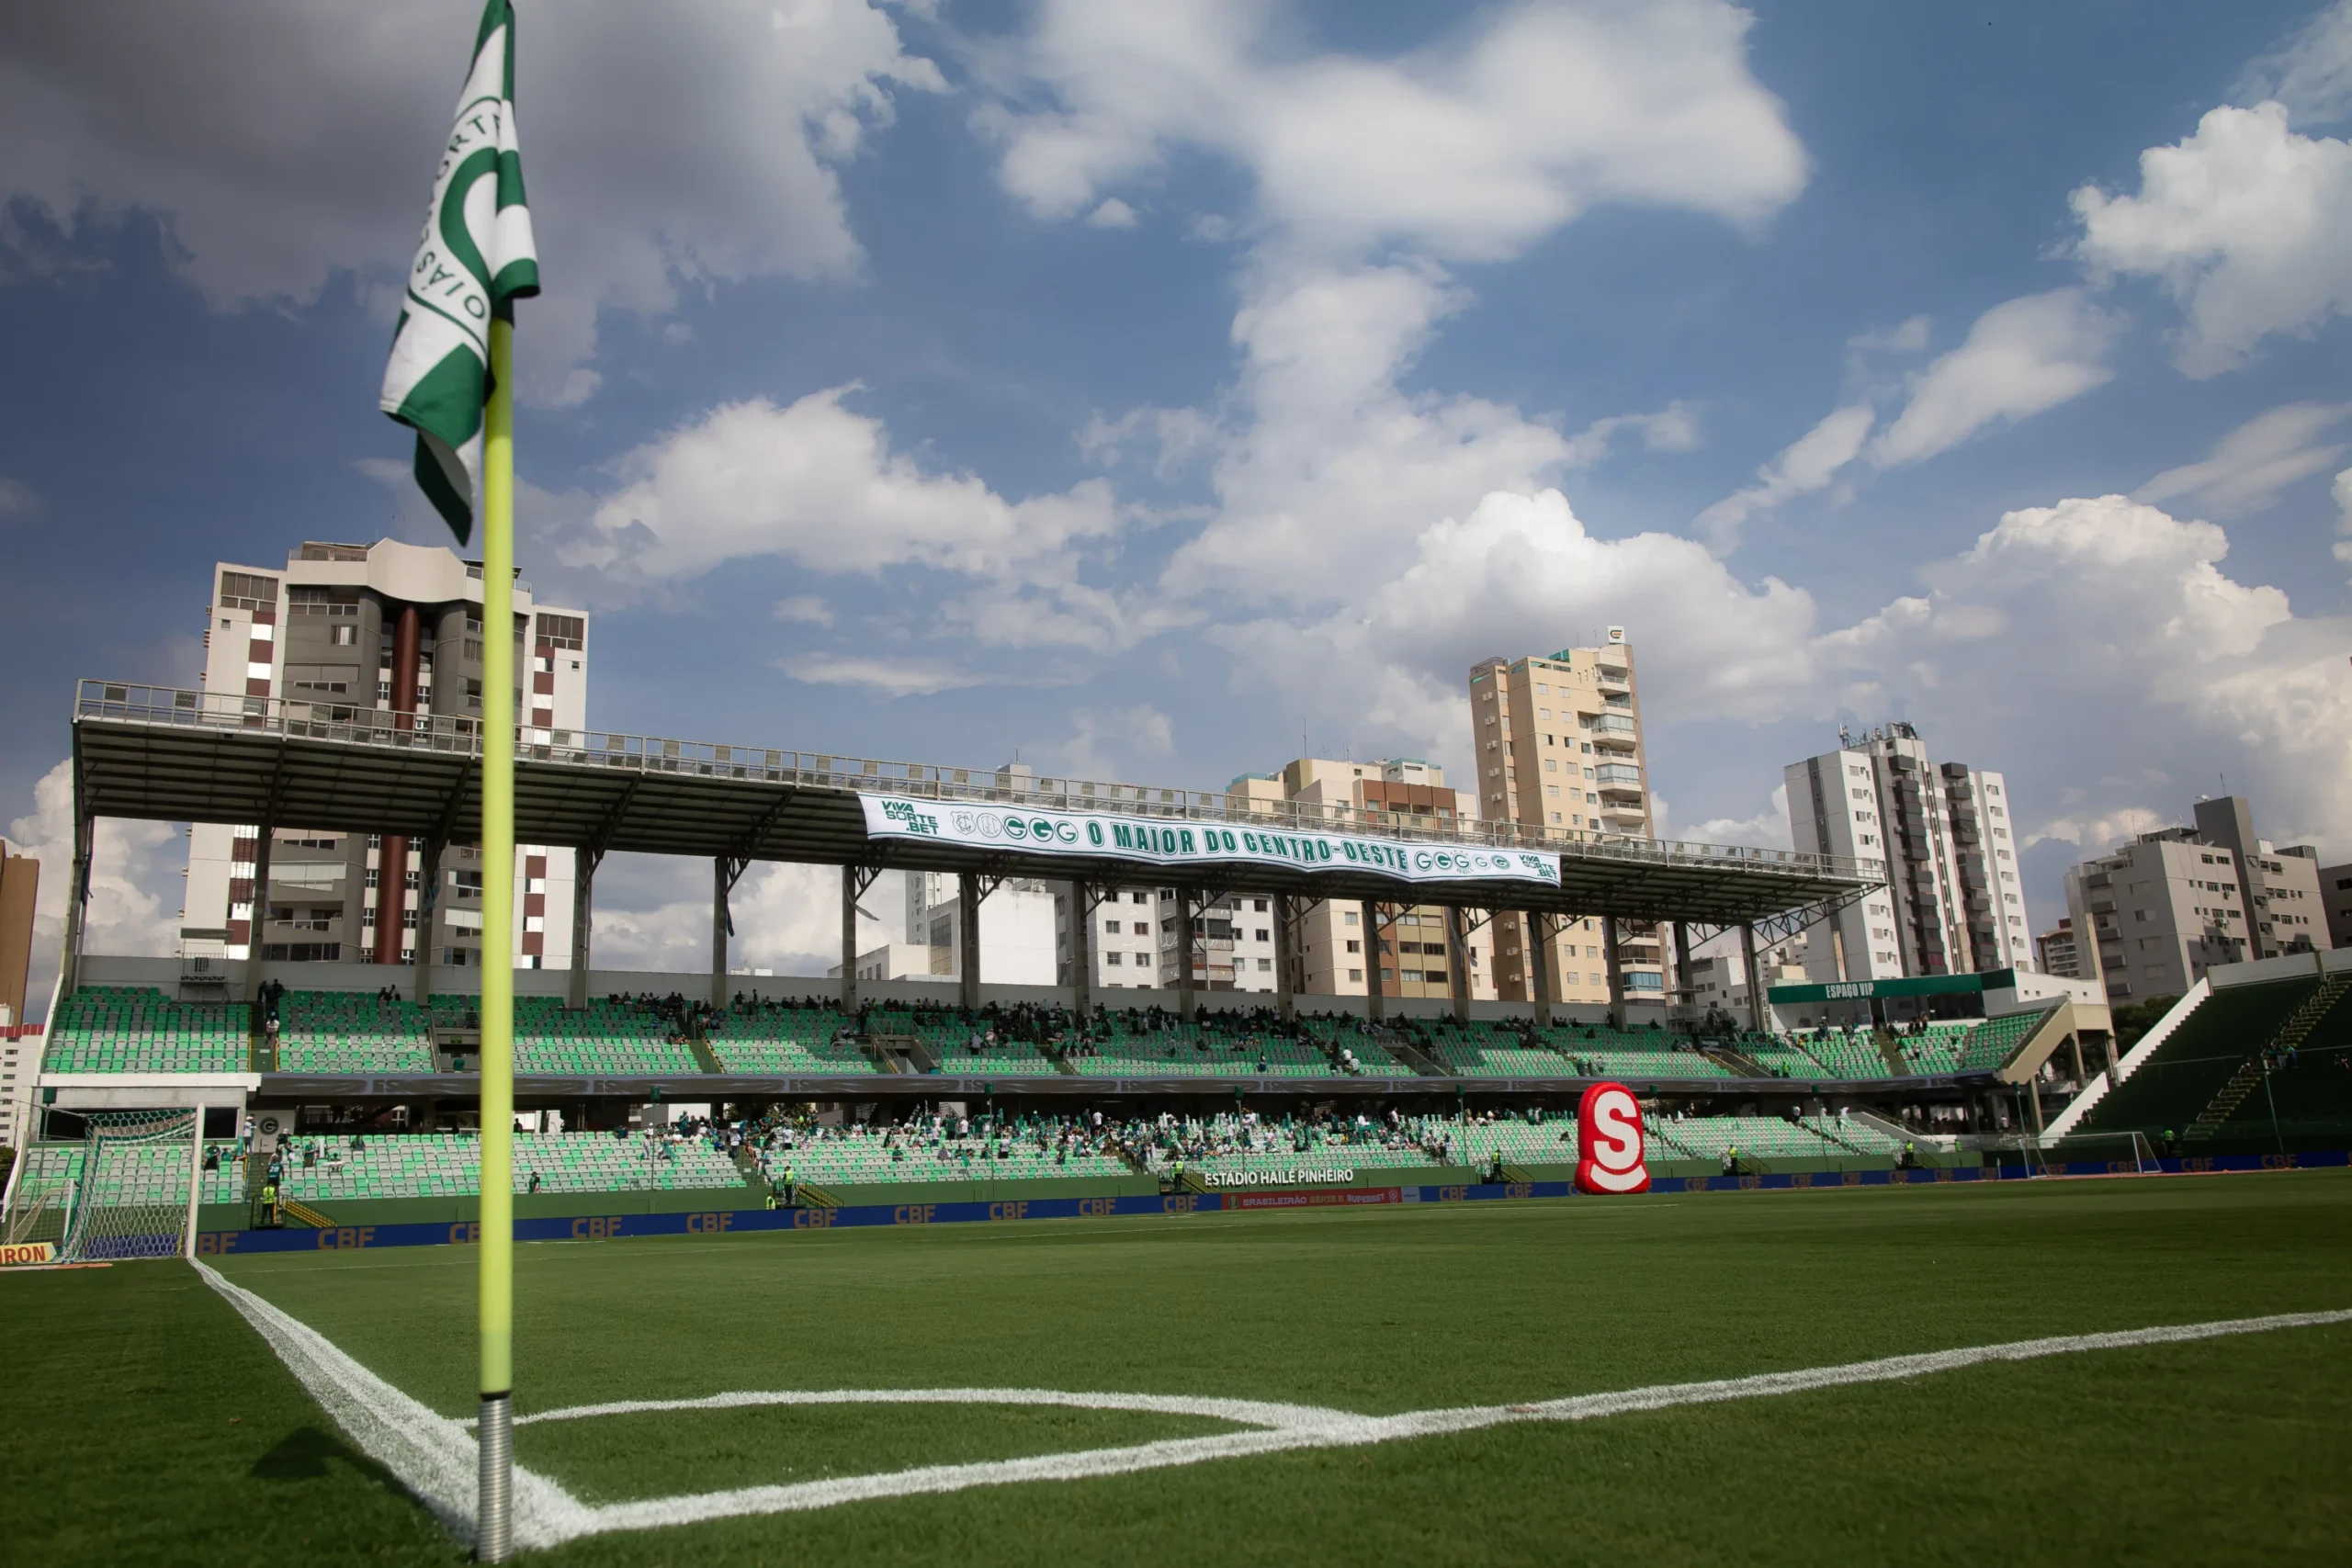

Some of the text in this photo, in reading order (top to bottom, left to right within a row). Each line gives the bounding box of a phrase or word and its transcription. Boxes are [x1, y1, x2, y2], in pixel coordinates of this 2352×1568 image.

[416, 251, 485, 320] OIÁS
[881, 801, 914, 812] VIVA
[886, 810, 936, 825] SORTE
[906, 821, 939, 835] .BET
[1086, 820, 1409, 873] O MAIOR DO CENTRO-OESTE
[1521, 861, 1555, 872] SORTE
[1537, 870, 1557, 879] .BET
[1825, 982, 1874, 998] ESPAÇO VIP
[1593, 1090, 1640, 1170] S
[1204, 1170, 1258, 1186] ESTÁDIO
[1297, 1168, 1354, 1184] PINHEIRO
[1684, 1178, 1710, 1191] CBF
[1738, 1175, 1762, 1190] CBF
[1243, 1195, 1307, 1206] BRASILEIRÃO
[1347, 1193, 1385, 1203] SUPERBET
[1439, 1186, 1468, 1201] CBF
[1505, 1183, 1533, 1199] CBF
[989, 1201, 1029, 1220] CBF
[1079, 1198, 1116, 1216] CBF
[1163, 1195, 1198, 1213] CBF
[686, 1213, 733, 1233] CBF
[794, 1208, 838, 1229] CBF
[894, 1204, 936, 1224] CBF
[449, 1223, 481, 1244] CB
[571, 1217, 622, 1238] CBF
[197, 1232, 239, 1256] BF
[317, 1226, 376, 1250] CBF
